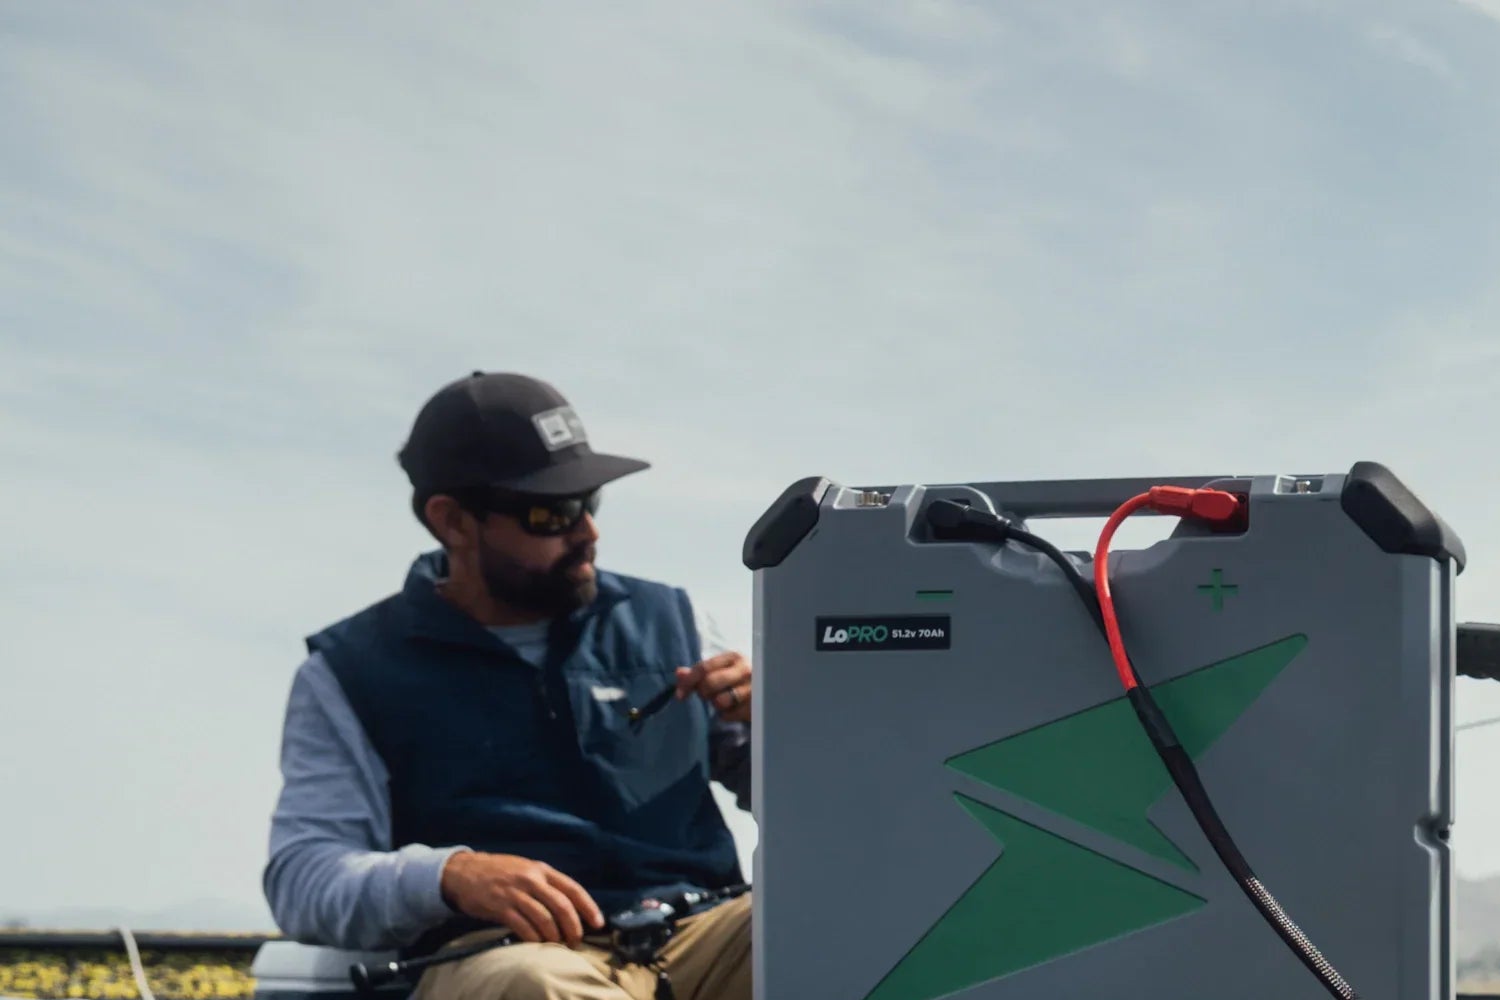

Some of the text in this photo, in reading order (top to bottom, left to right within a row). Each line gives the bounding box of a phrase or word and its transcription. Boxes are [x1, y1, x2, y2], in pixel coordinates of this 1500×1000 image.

[822, 625, 945, 643] LoPRO 51.2v 70Ah
